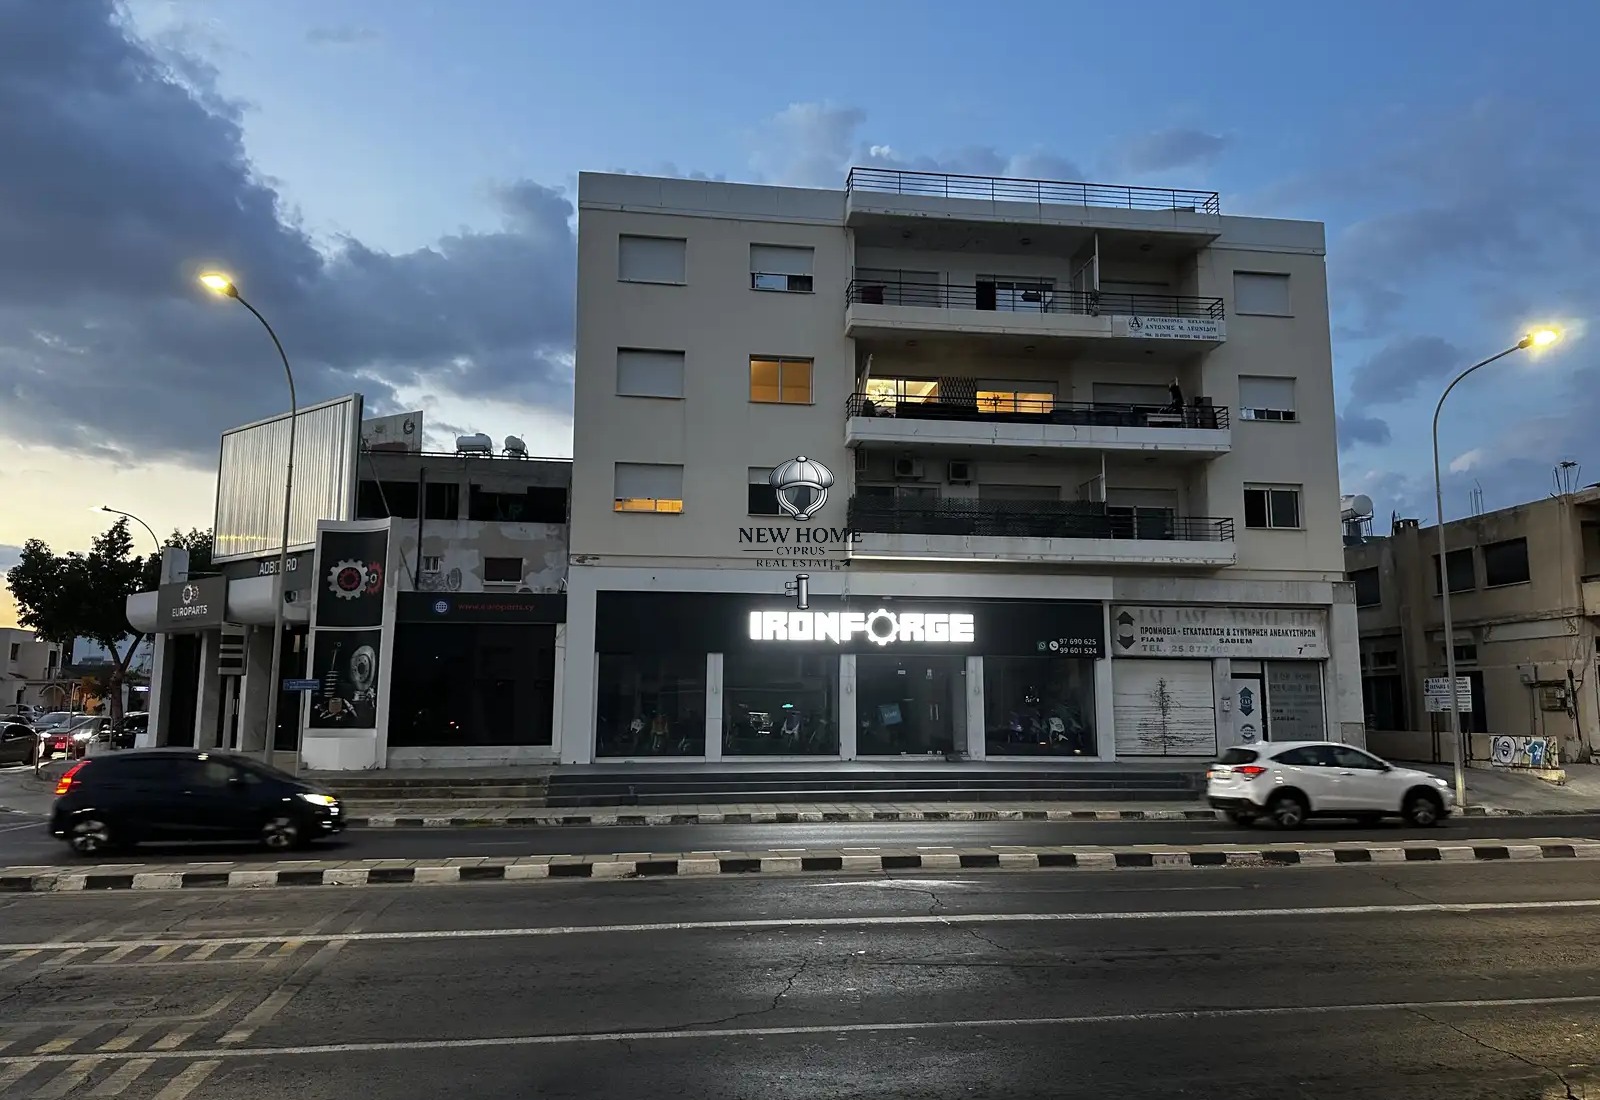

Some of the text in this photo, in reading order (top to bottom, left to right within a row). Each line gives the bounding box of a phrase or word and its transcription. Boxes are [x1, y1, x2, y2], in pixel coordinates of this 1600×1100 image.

[259, 557, 297, 575] ADBORD
[172, 604, 208, 617] EUROPARTS
[750, 608, 975, 645] IRONFORGE
[1140, 626, 1176, 635] ΠΡΟΜΗΘΕΙΑ
[1182, 627, 1225, 636] ΕΓΚΑΤΑΣΤΑΣΗ
[1226, 628, 1231, 636] &
[1232, 628, 1268, 637] ΣΥΝΤΗΡΗΣΗ
[1269, 628, 1316, 638] ΑΝΕΛΚΥΣΤΗΡΩΝ
[1142, 644, 1166, 653] TEL.
